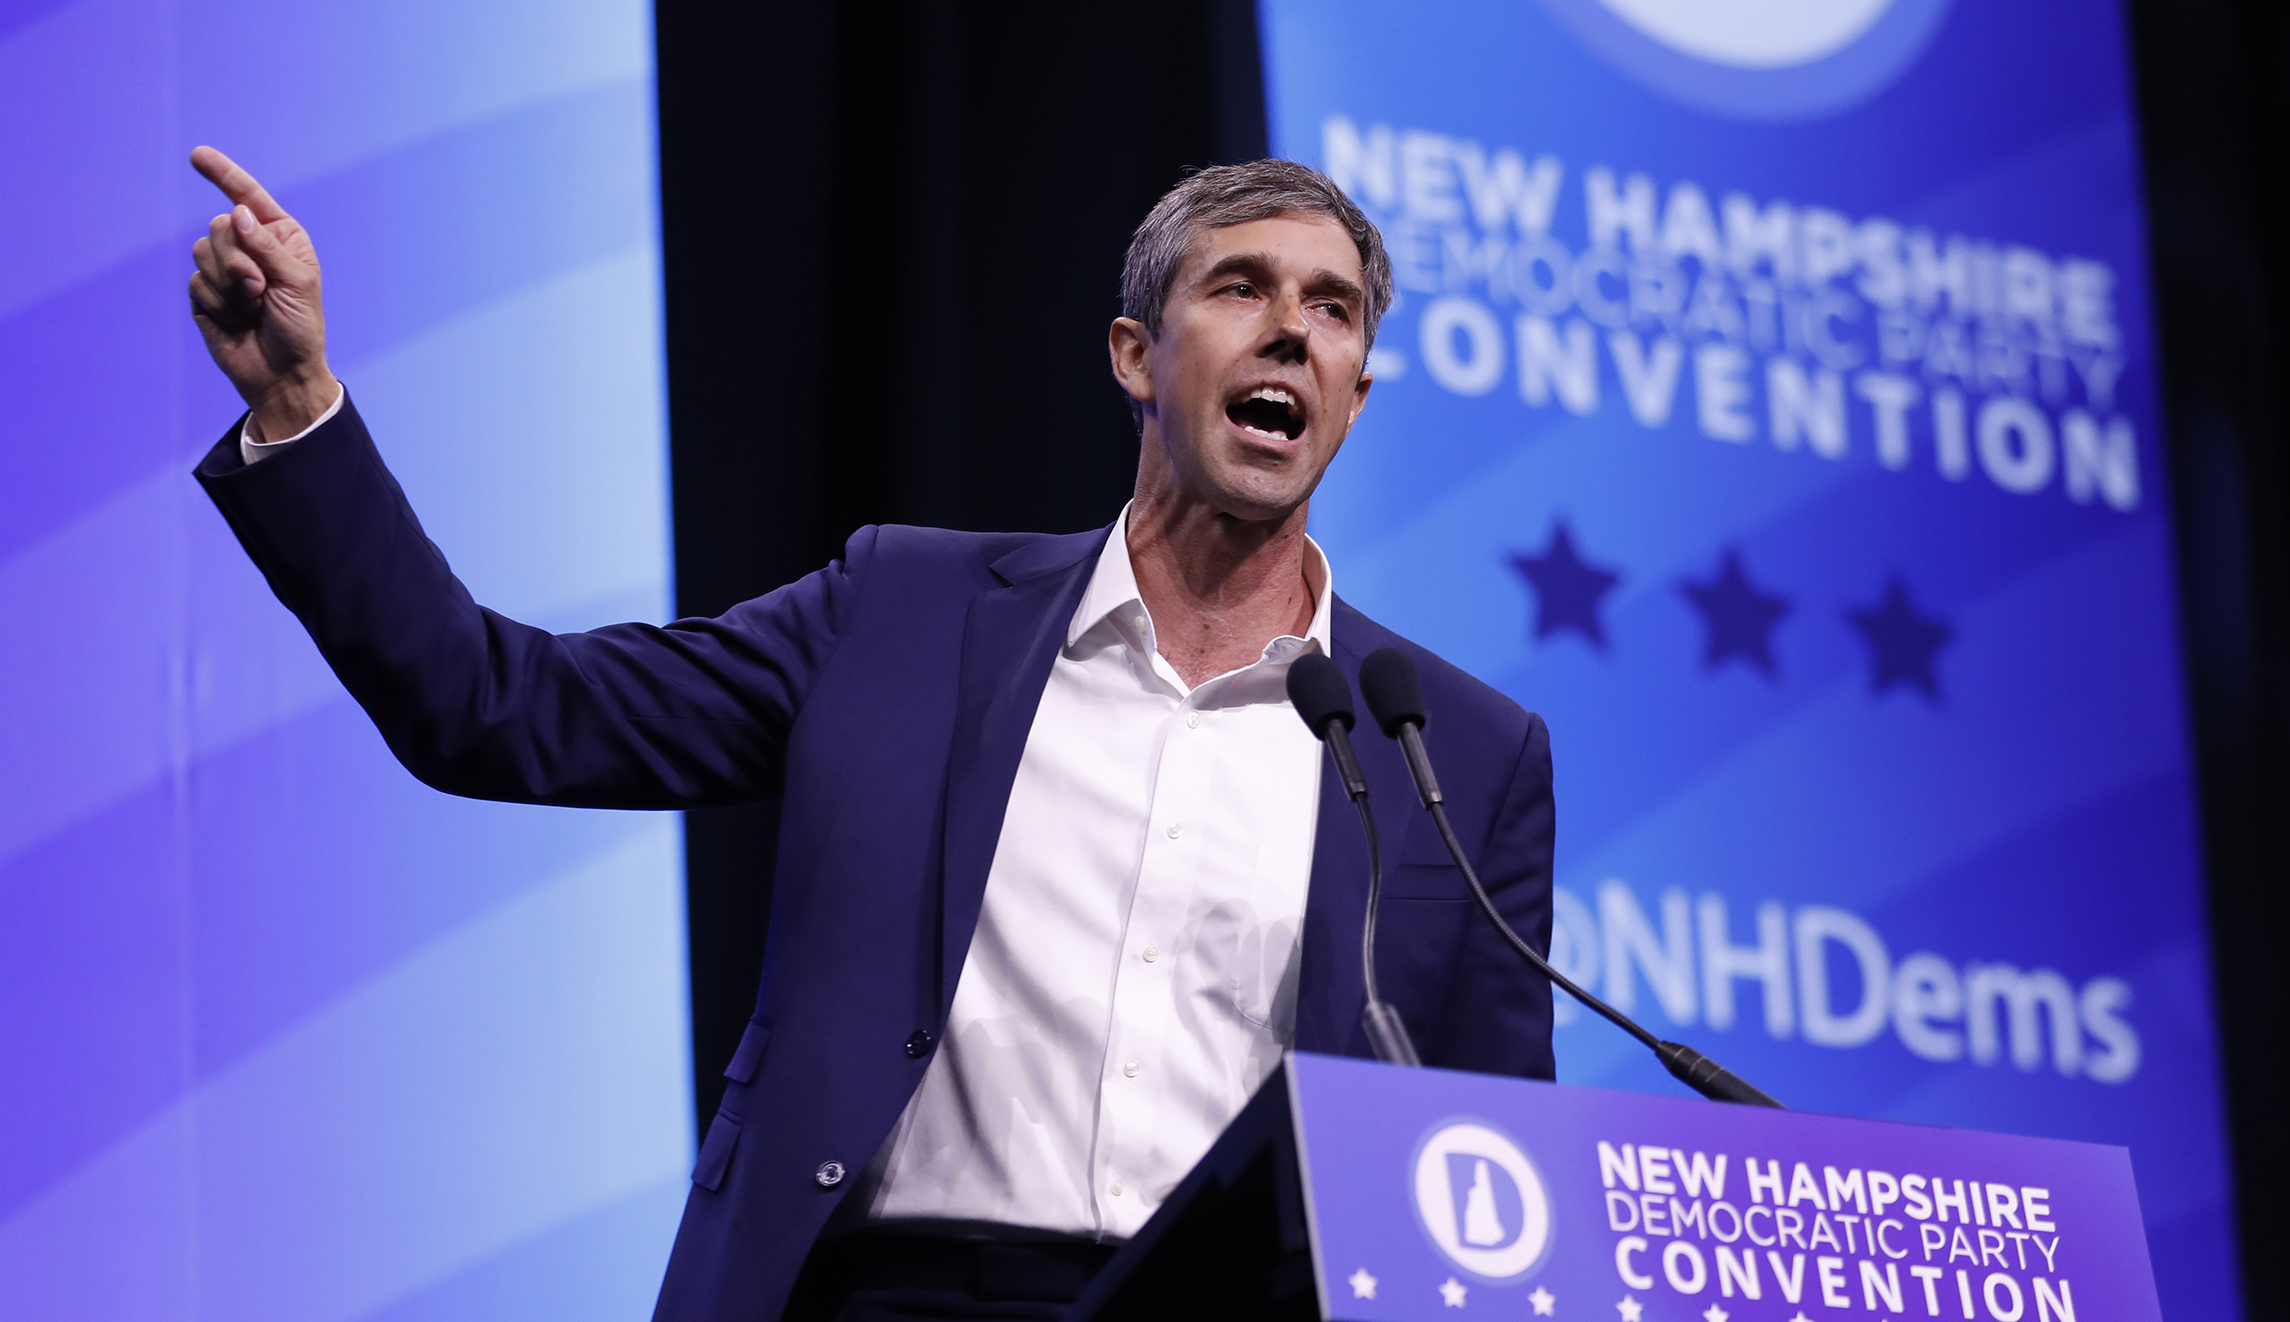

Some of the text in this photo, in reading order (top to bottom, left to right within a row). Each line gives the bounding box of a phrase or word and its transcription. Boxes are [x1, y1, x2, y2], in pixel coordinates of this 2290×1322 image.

[1322, 114, 2119, 348] NEW HAMPSHIRE
[1378, 216, 2124, 412] EMOCRATIC PARTY
[1364, 298, 2140, 514] ONVENTION
[1597, 1139, 2056, 1233] NEW HAMPSHIRE
[1605, 1189, 2061, 1274] DEMOCRATIC PARTY
[1615, 1235, 2077, 1322] CONVENTION
